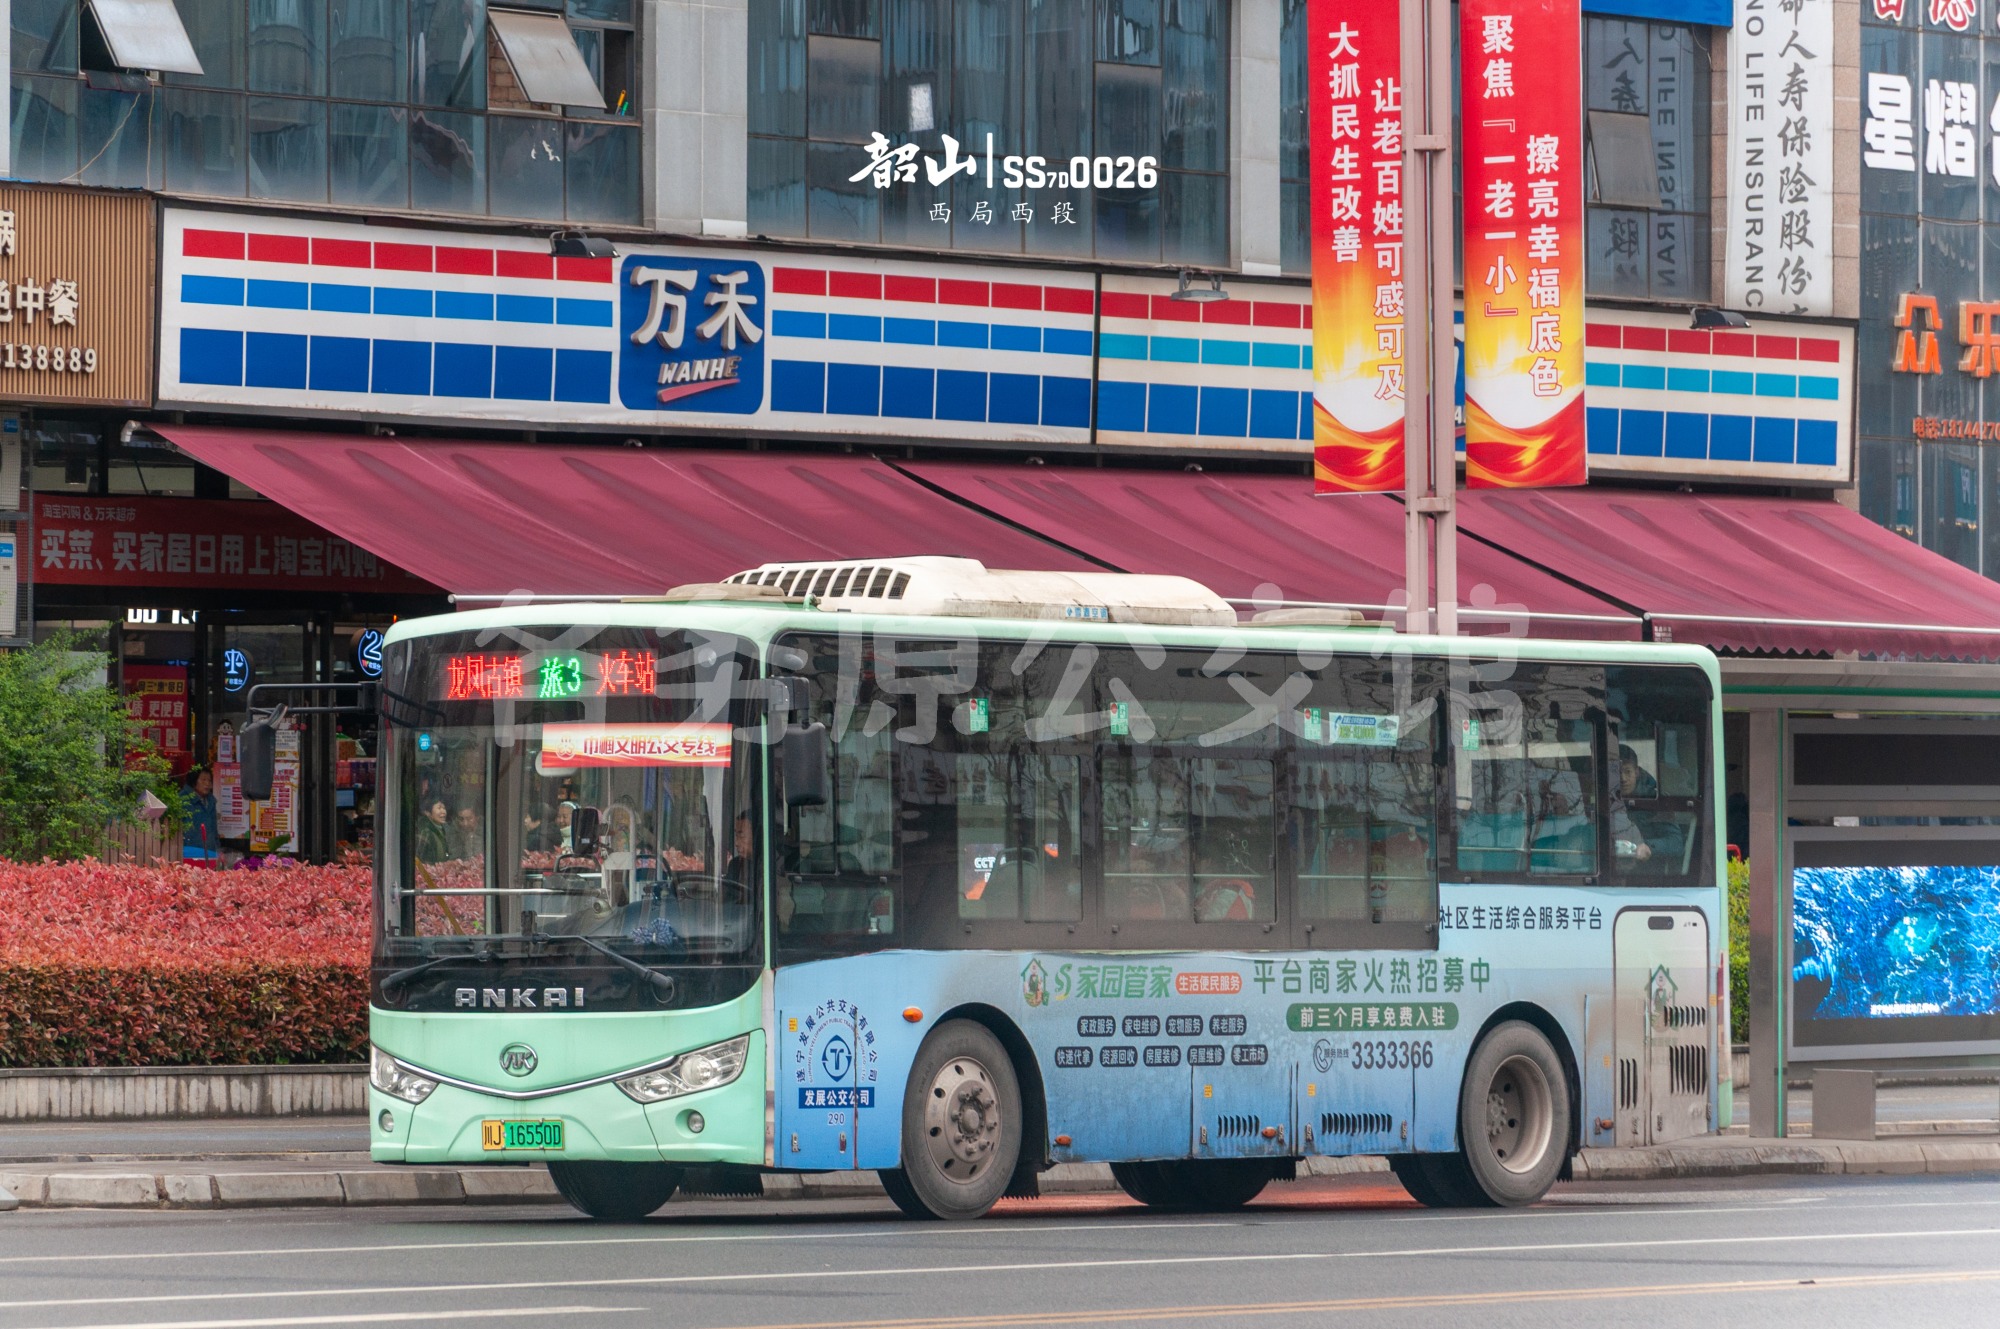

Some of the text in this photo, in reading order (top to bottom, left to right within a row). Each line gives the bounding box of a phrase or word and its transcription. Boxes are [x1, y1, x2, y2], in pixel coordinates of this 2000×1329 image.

[1745, 52, 1764, 121] LIFE
[1864, 72, 2000, 187] 星熠
[1328, 21, 1363, 263] 大抓民生改善
[1778, 0, 1819, 315] 人寿保险股份
[1370, 77, 1404, 401] 让老百姓可感可及
[1526, 134, 1562, 398] 擦亮幸福底色
[630, 265, 763, 350] 万禾
[658, 356, 742, 384] WANHE
[447, 651, 657, 699] 龙凤古镇 旅3 火车站
[583, 734, 717, 757] 巾帼文明公交专线
[1438, 905, 1602, 931] 社区生活综合服务平台
[1075, 964, 1173, 999] 家园管家
[1178, 974, 1242, 992] 生活便民服务
[1253, 956, 1490, 994] 平台商家火热招募中
[455, 987, 584, 1008] ANKAI
[1080, 1017, 1114, 1035] 家政服务
[1124, 1017, 1158, 1035] 家电维修
[1168, 1016, 1201, 1034] 宠物服务
[1212, 1016, 1245, 1034] 养老服务
[1300, 1005, 1446, 1028] 前三个月享免费入驻
[1057, 1048, 1090, 1066] 快递代拿
[1101, 1048, 1135, 1065] 资源回收
[1145, 1047, 1179, 1065] 房屋装修
[1189, 1046, 1222, 1064] 房屋维修
[1233, 1046, 1265, 1063] 零工市场
[1351, 1040, 1433, 1070] 3333366
[804, 1089, 870, 1106] 发展公交公司
[828, 1112, 845, 1125] 290
